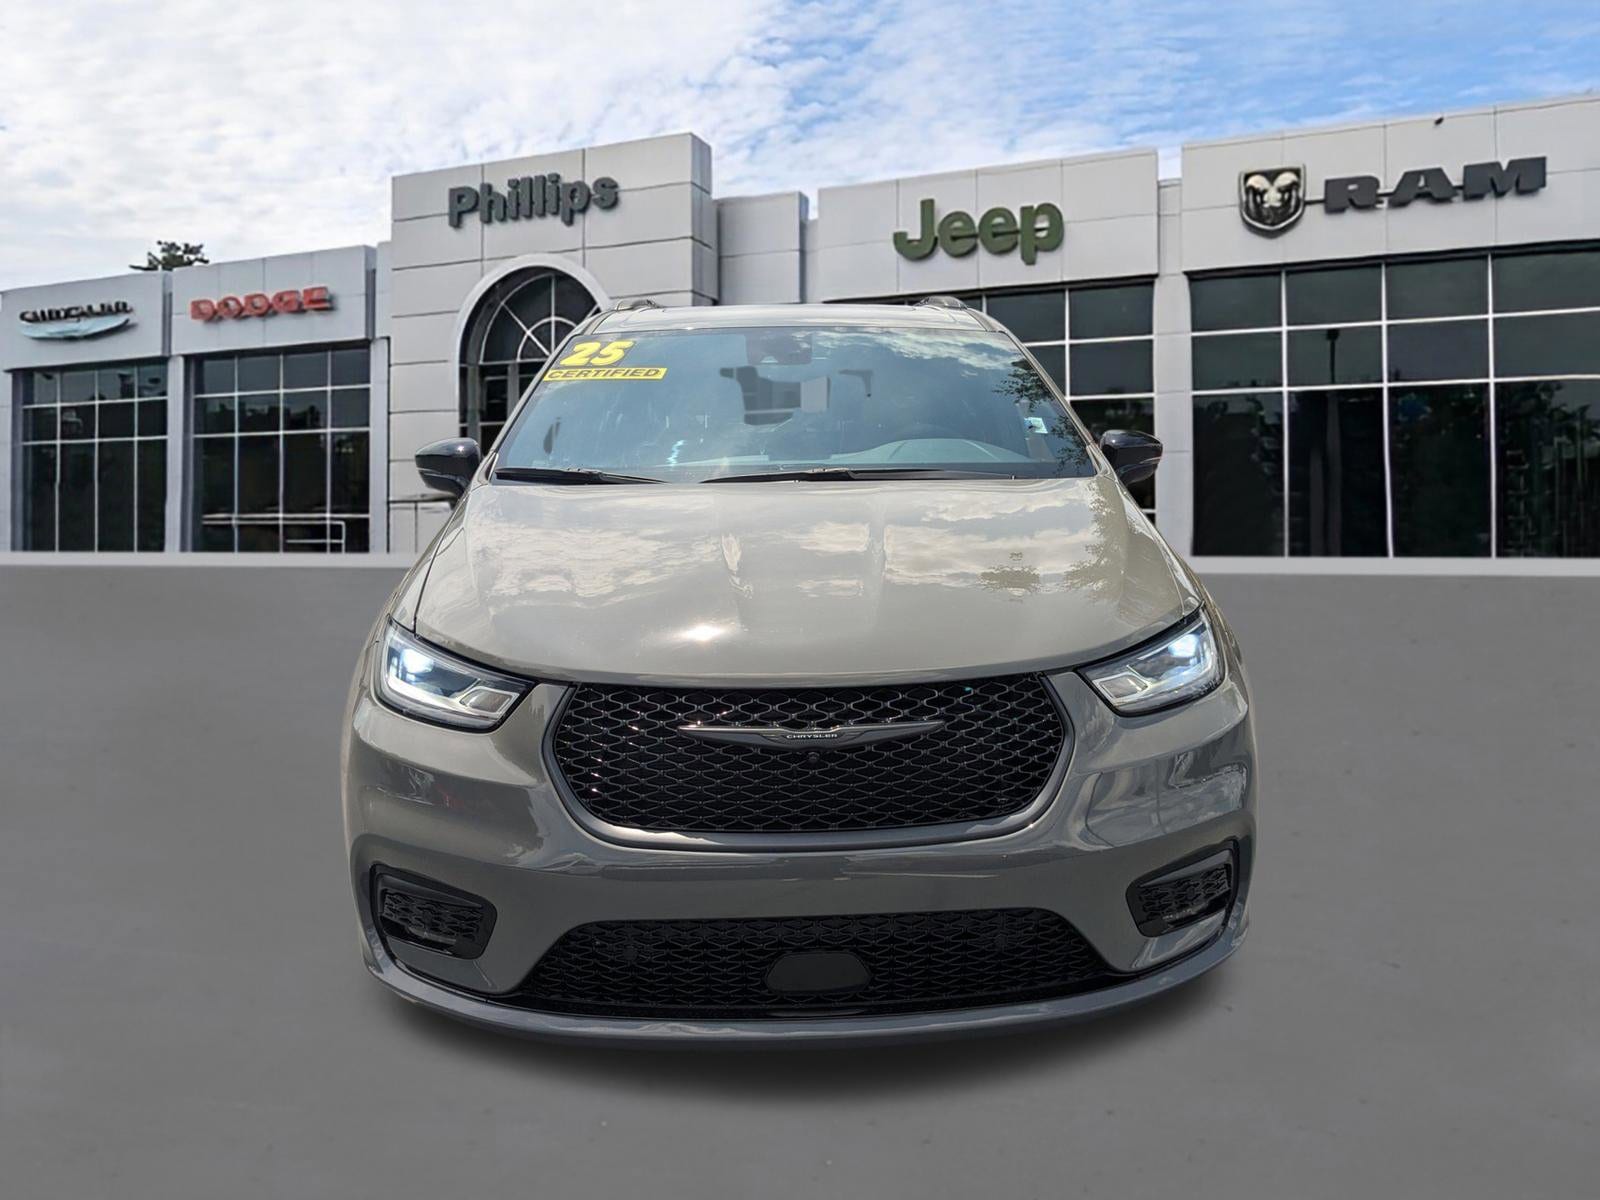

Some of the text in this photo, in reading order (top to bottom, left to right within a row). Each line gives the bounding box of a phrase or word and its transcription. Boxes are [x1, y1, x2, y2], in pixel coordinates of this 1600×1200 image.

[448, 172, 620, 229] Phillips
[1324, 156, 1547, 214] RAM
[893, 198, 1065, 266] Jeep
[190, 286, 331, 322] DODGE
[548, 368, 660, 379] CERTIFIED
[559, 340, 635, 367] 25
